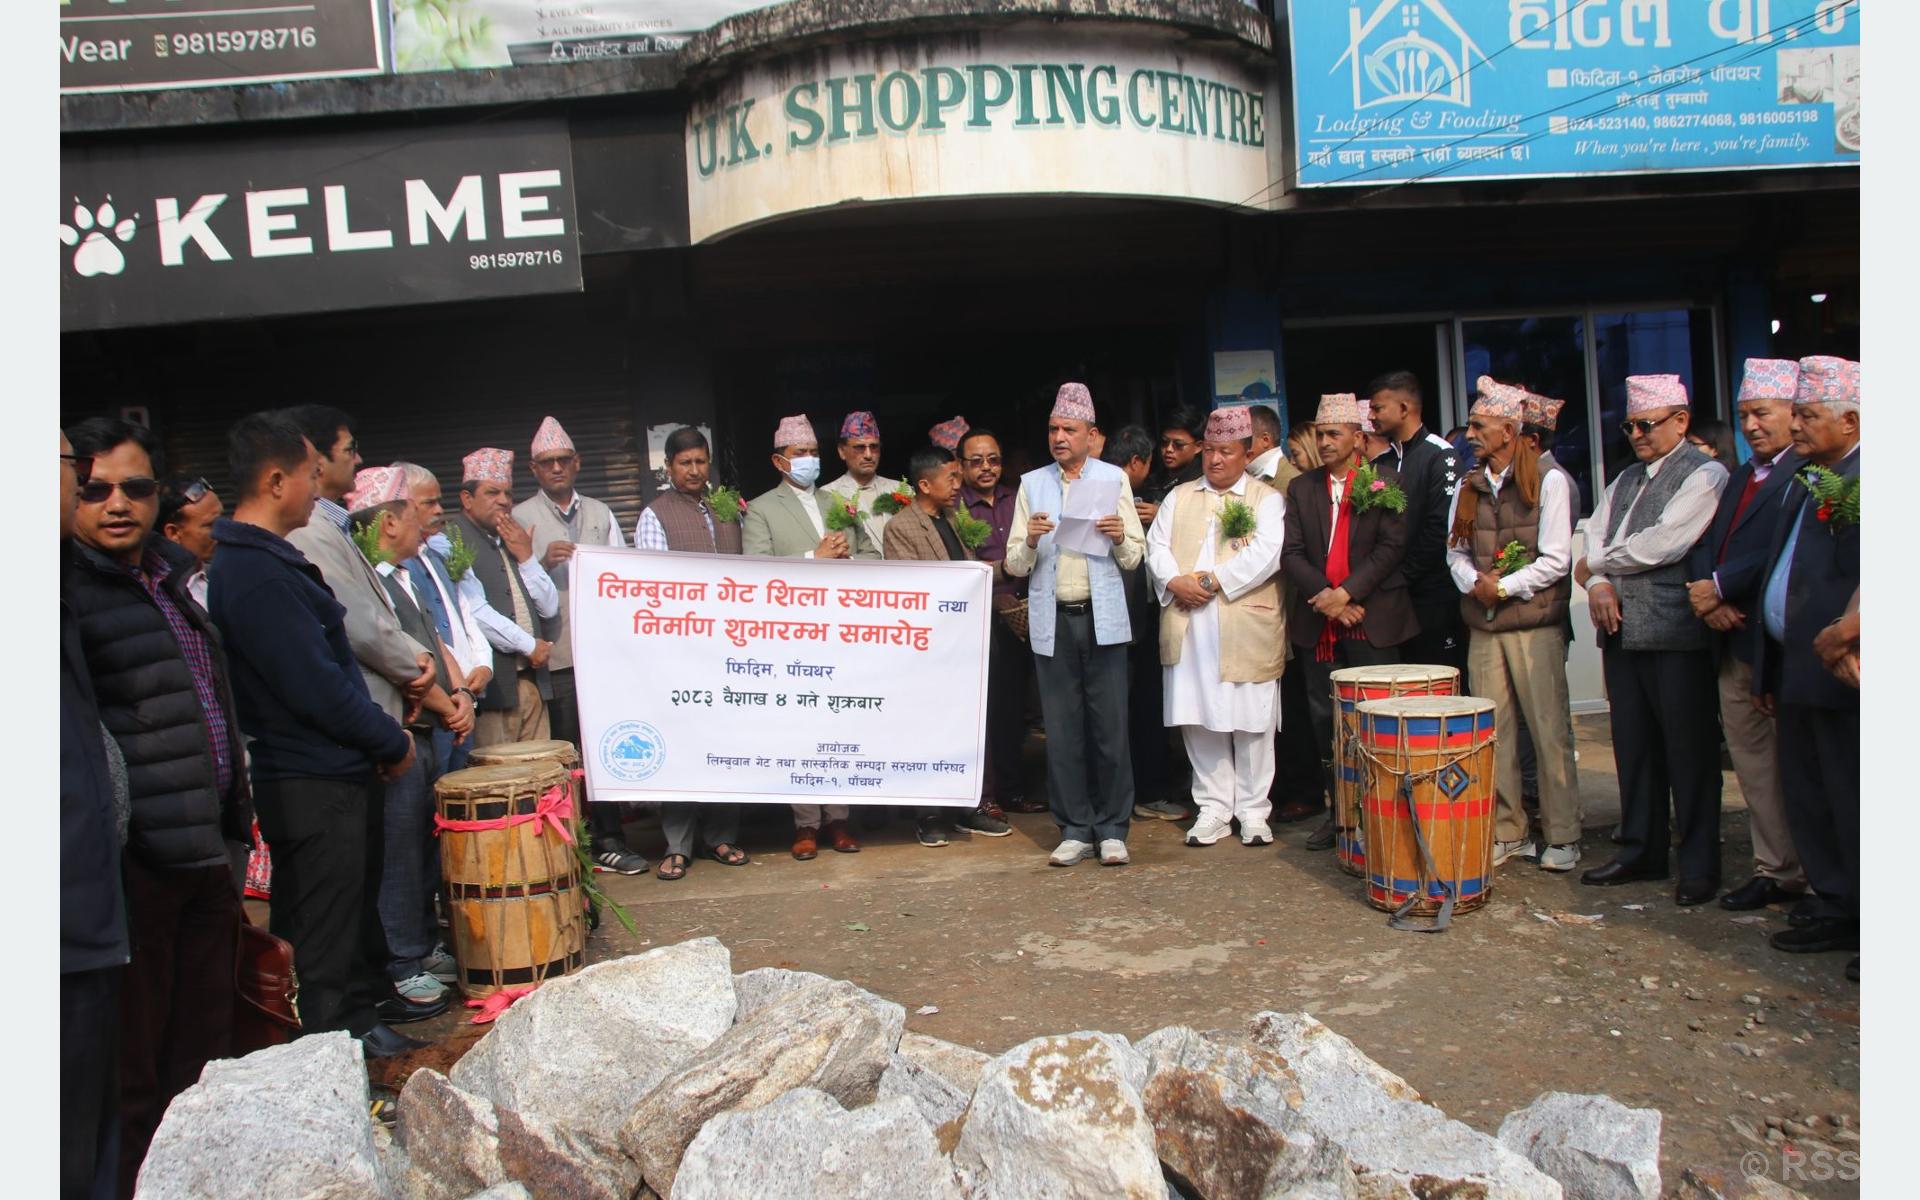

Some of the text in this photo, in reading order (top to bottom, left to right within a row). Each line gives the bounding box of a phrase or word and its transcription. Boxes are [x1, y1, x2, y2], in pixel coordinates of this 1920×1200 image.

[551, 18, 673, 36] ALL IN BEAUTY SERVICES
[172, 26, 317, 55] 9815978716
[692, 62, 1265, 180] U.K. SHOPPING CENTRE
[1314, 109, 1522, 137] Lodging & Fooding
[1740, 110, 1818, 126] 9816005198
[1574, 139, 1618, 155] When
[1621, 138, 1666, 158] you're
[1714, 135, 1757, 156] you're
[1758, 134, 1810, 156] family.
[155, 169, 566, 267] KELME
[469, 249, 563, 270] 9815978716
[598, 572, 968, 613] लिम्बुवान गेट शिला स्थापना तथा
[633, 609, 932, 651] निर्माण शुभारम्भ समारोह
[787, 658, 835, 680] पाँचथर
[671, 686, 885, 713] २०८३ वैशाख ४ गते शुक्रबार
[816, 741, 861, 753] आयोजक
[706, 753, 751, 769] लिम्बुवान
[755, 756, 771, 767] गेट
[776, 758, 795, 768] तथा
[848, 775, 884, 788] पाँचथर
